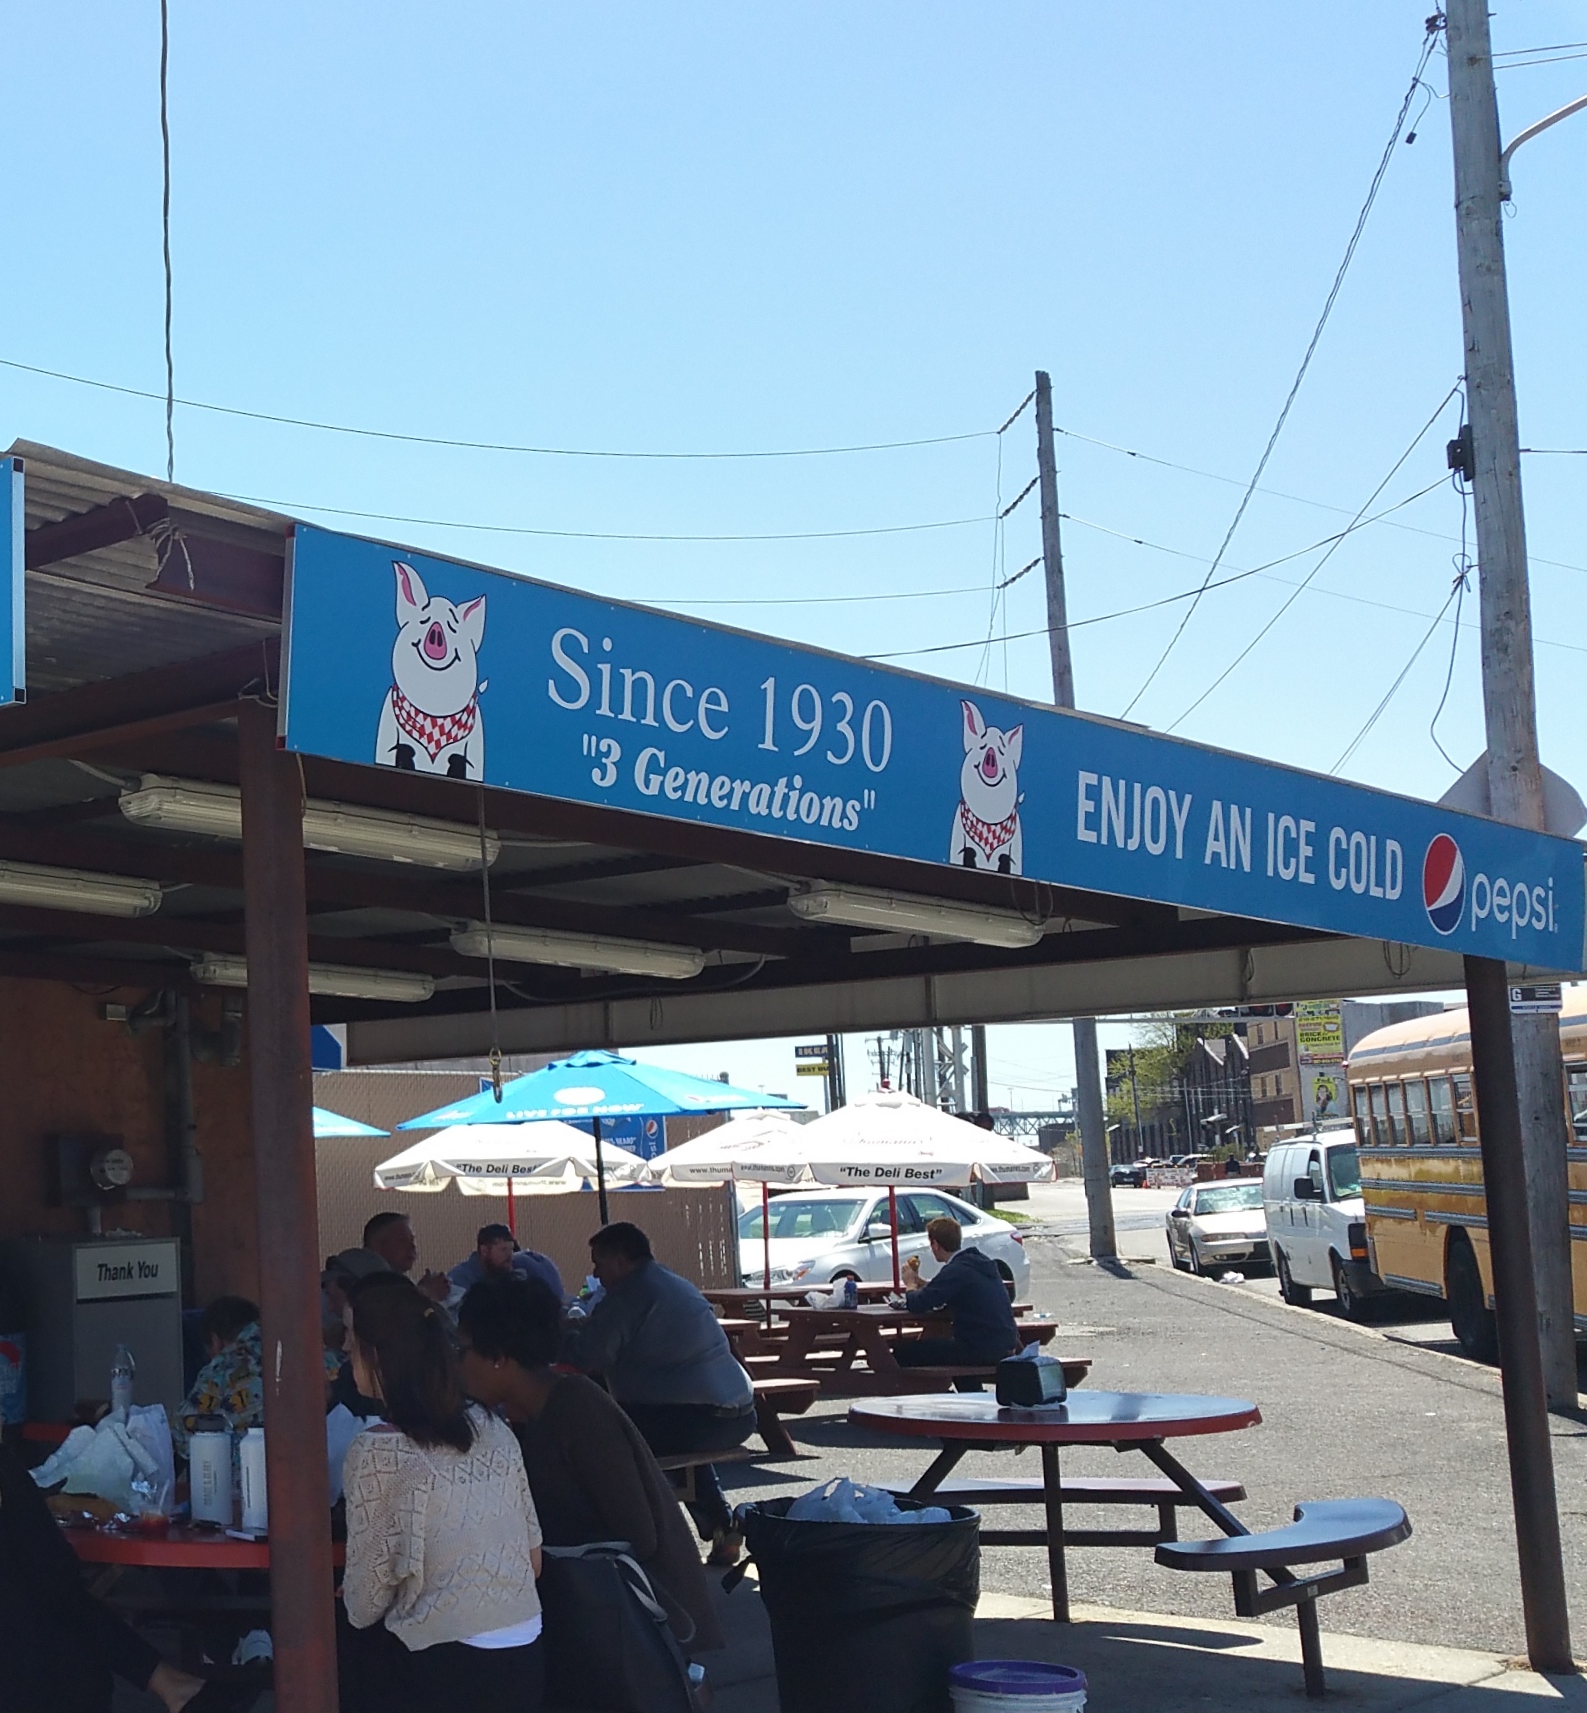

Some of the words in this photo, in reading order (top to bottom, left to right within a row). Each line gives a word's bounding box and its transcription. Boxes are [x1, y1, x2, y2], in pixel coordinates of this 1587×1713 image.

[547, 627, 731, 740] Since
[757, 675, 892, 772] 1930
[581, 733, 618, 788] "3
[634, 747, 876, 832] Generations"
[1077, 769, 1193, 861] ENJOY
[1205, 799, 1252, 873] AN
[1267, 811, 1316, 886] ICE
[1328, 825, 1403, 901] COLD
[1471, 876, 1555, 940] pepsi
[1512, 988, 1522, 1001] G
[457, 1164, 483, 1174] "The
[486, 1163, 509, 1175] Deli
[840, 1166, 872, 1178] "The
[874, 1166, 901, 1178] Deli
[904, 1167, 943, 1180] Best"
[97, 1261, 134, 1281] Thank
[137, 1260, 159, 1278] You
